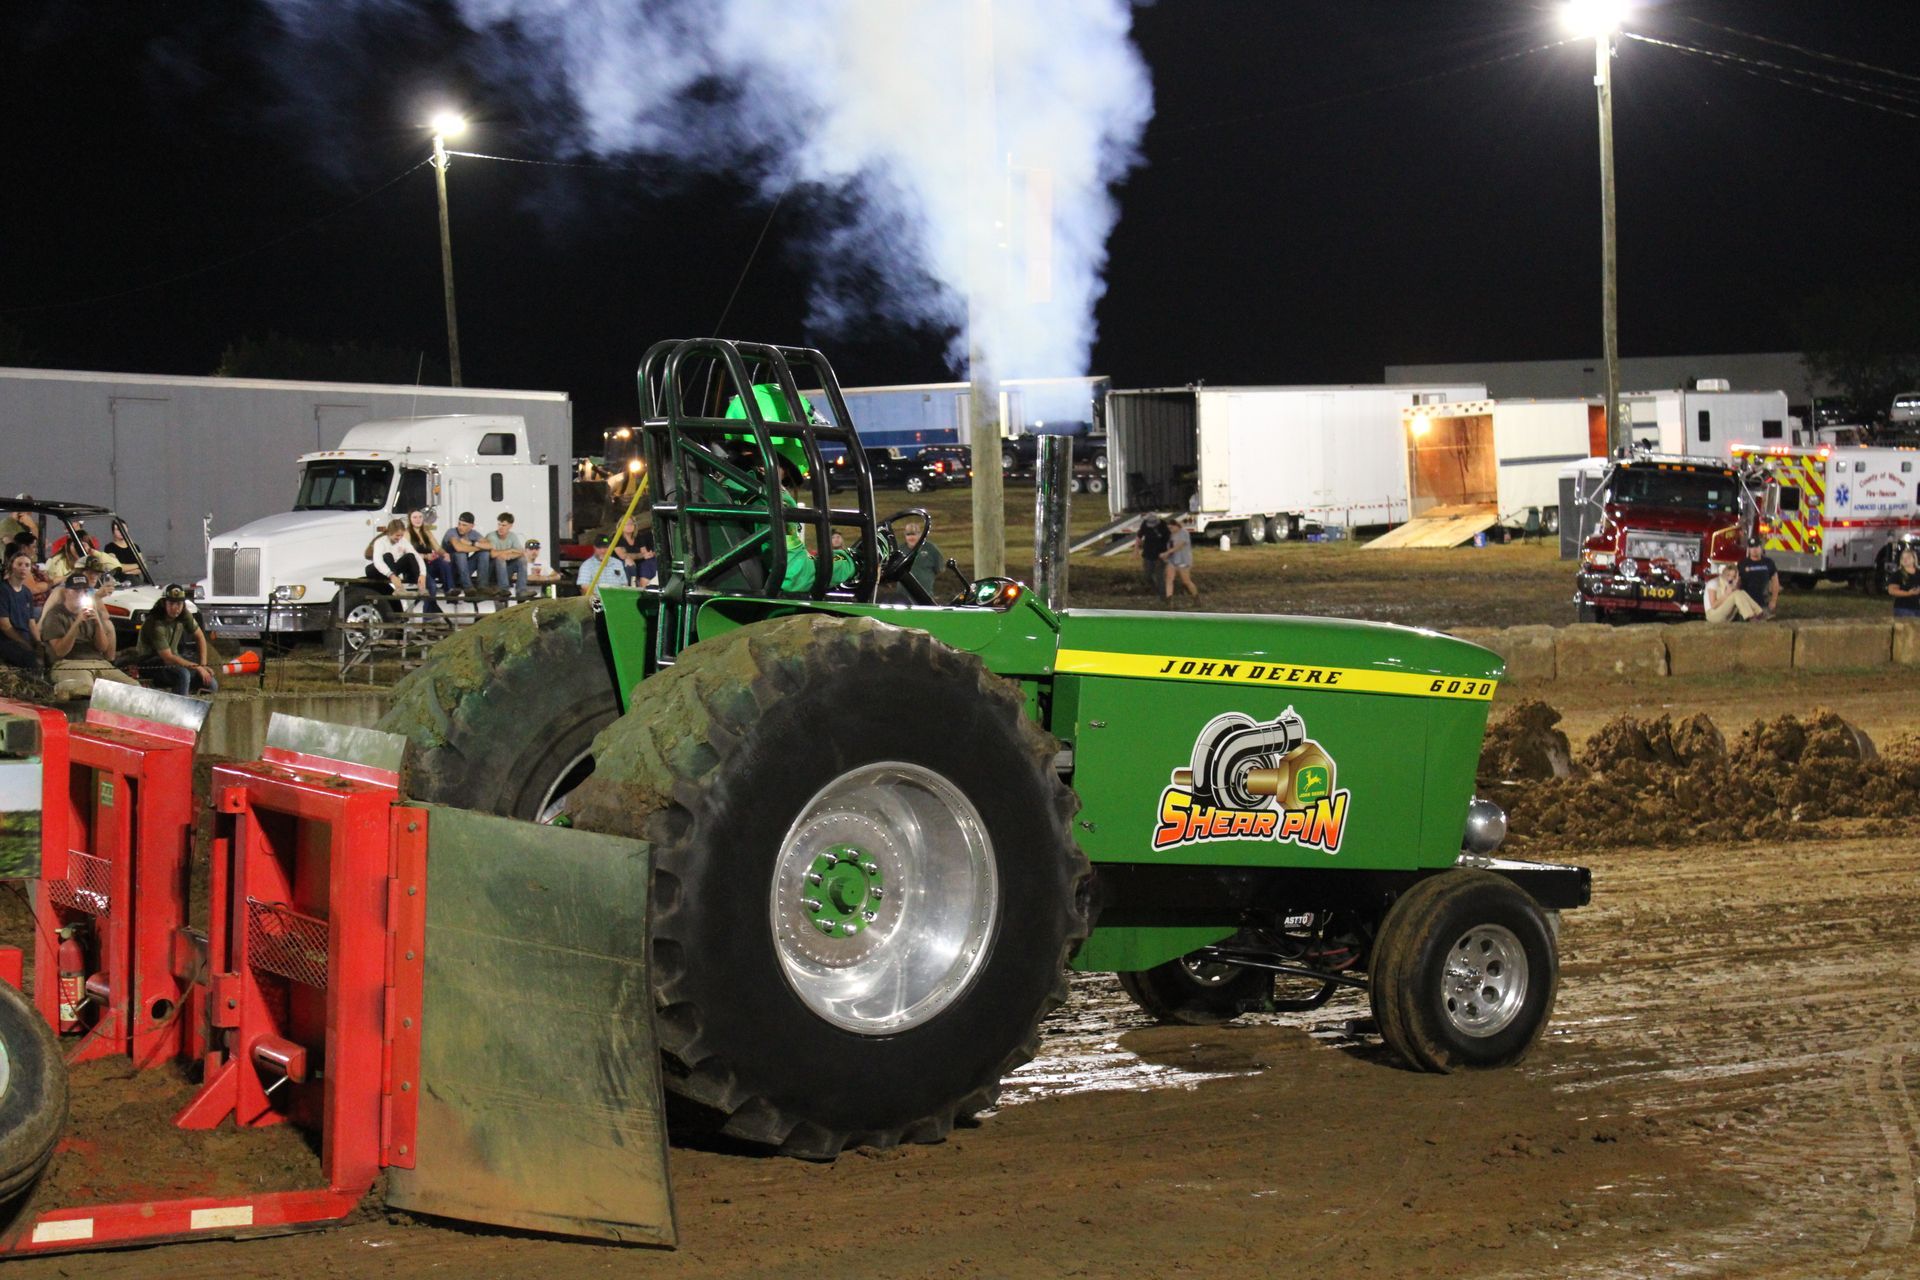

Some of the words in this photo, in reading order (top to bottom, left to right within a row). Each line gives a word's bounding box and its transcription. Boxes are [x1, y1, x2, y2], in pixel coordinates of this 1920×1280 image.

[1640, 585, 1675, 599] 1409
[1160, 660, 1240, 678] JOHN
[1247, 665, 1343, 685] DEERE
[1429, 679, 1492, 696] 6030
[1155, 789, 1277, 847] SHEAR
[1280, 792, 1347, 849] PIN
